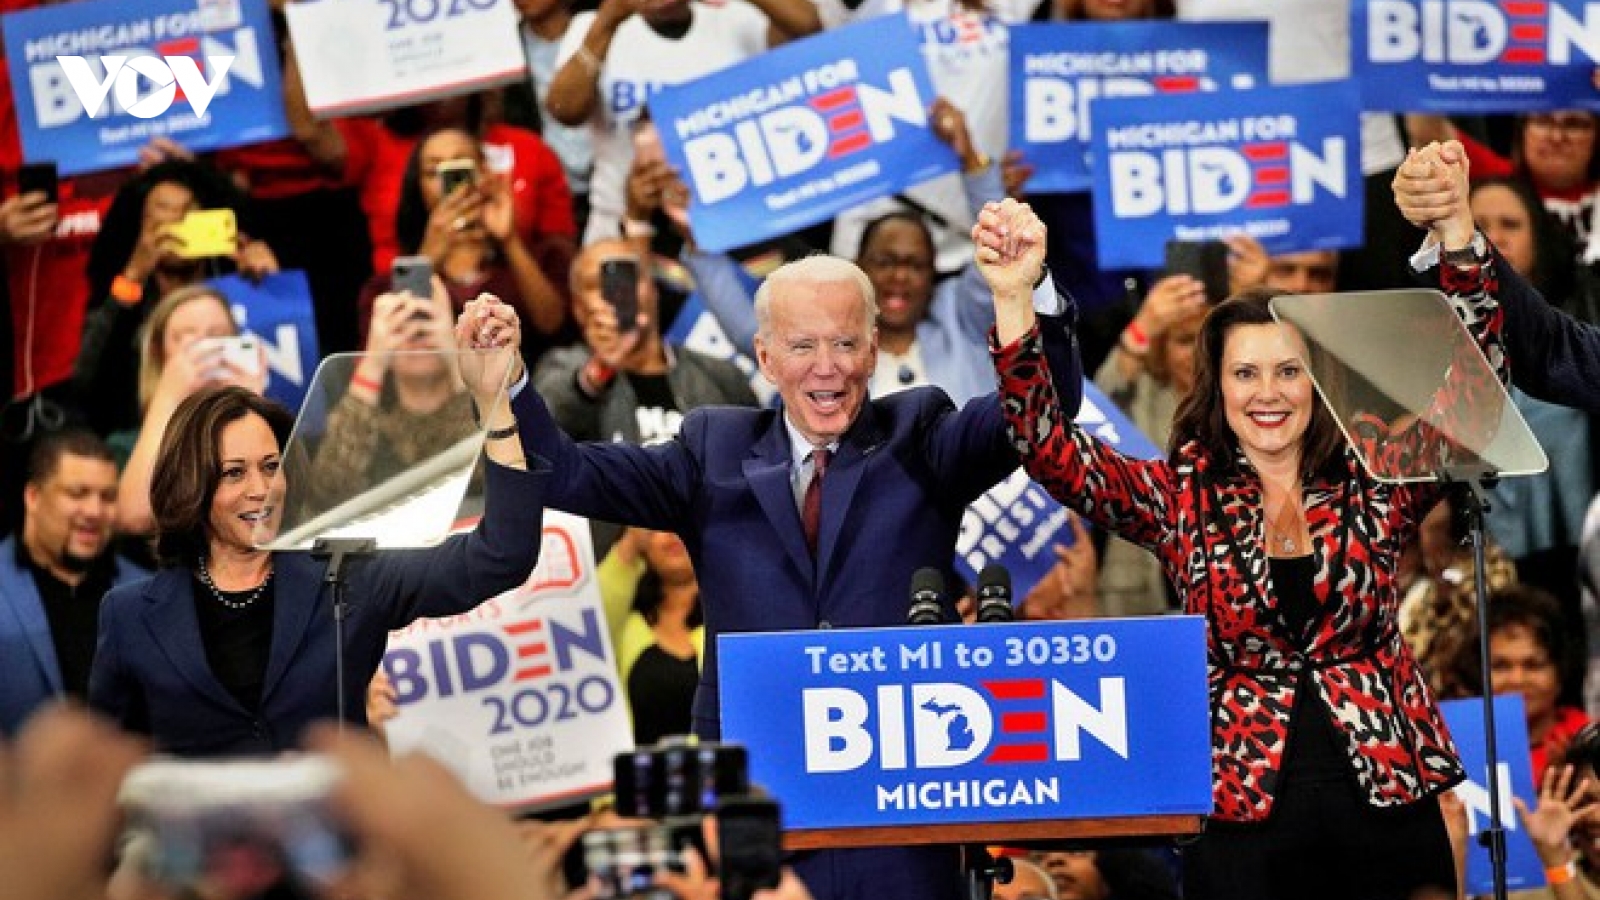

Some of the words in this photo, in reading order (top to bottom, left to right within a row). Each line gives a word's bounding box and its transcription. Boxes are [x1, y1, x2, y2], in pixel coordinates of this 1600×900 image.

[23, 18, 150, 63] MICHIGAN
[377, 0, 500, 30] 20
[1368, 0, 1600, 66] BIDEN
[1025, 50, 1153, 76] MICHIGAN
[1155, 48, 1208, 74] FOR
[674, 75, 803, 141] MICHIGAN
[803, 58, 859, 94] FOR
[683, 66, 927, 205] BIDEN
[1106, 118, 1240, 150] MICHIGAN
[1241, 113, 1297, 142] FOR
[1109, 134, 1347, 218] BIDEN
[382, 606, 606, 707] BIDEN
[805, 645, 886, 674] Text
[900, 641, 942, 670] MI
[956, 641, 993, 669] to
[1005, 634, 1117, 665] 30330
[481, 674, 616, 737] 2020
[802, 676, 1129, 774] BIDEN
[877, 777, 1060, 811] MICHIGAN
